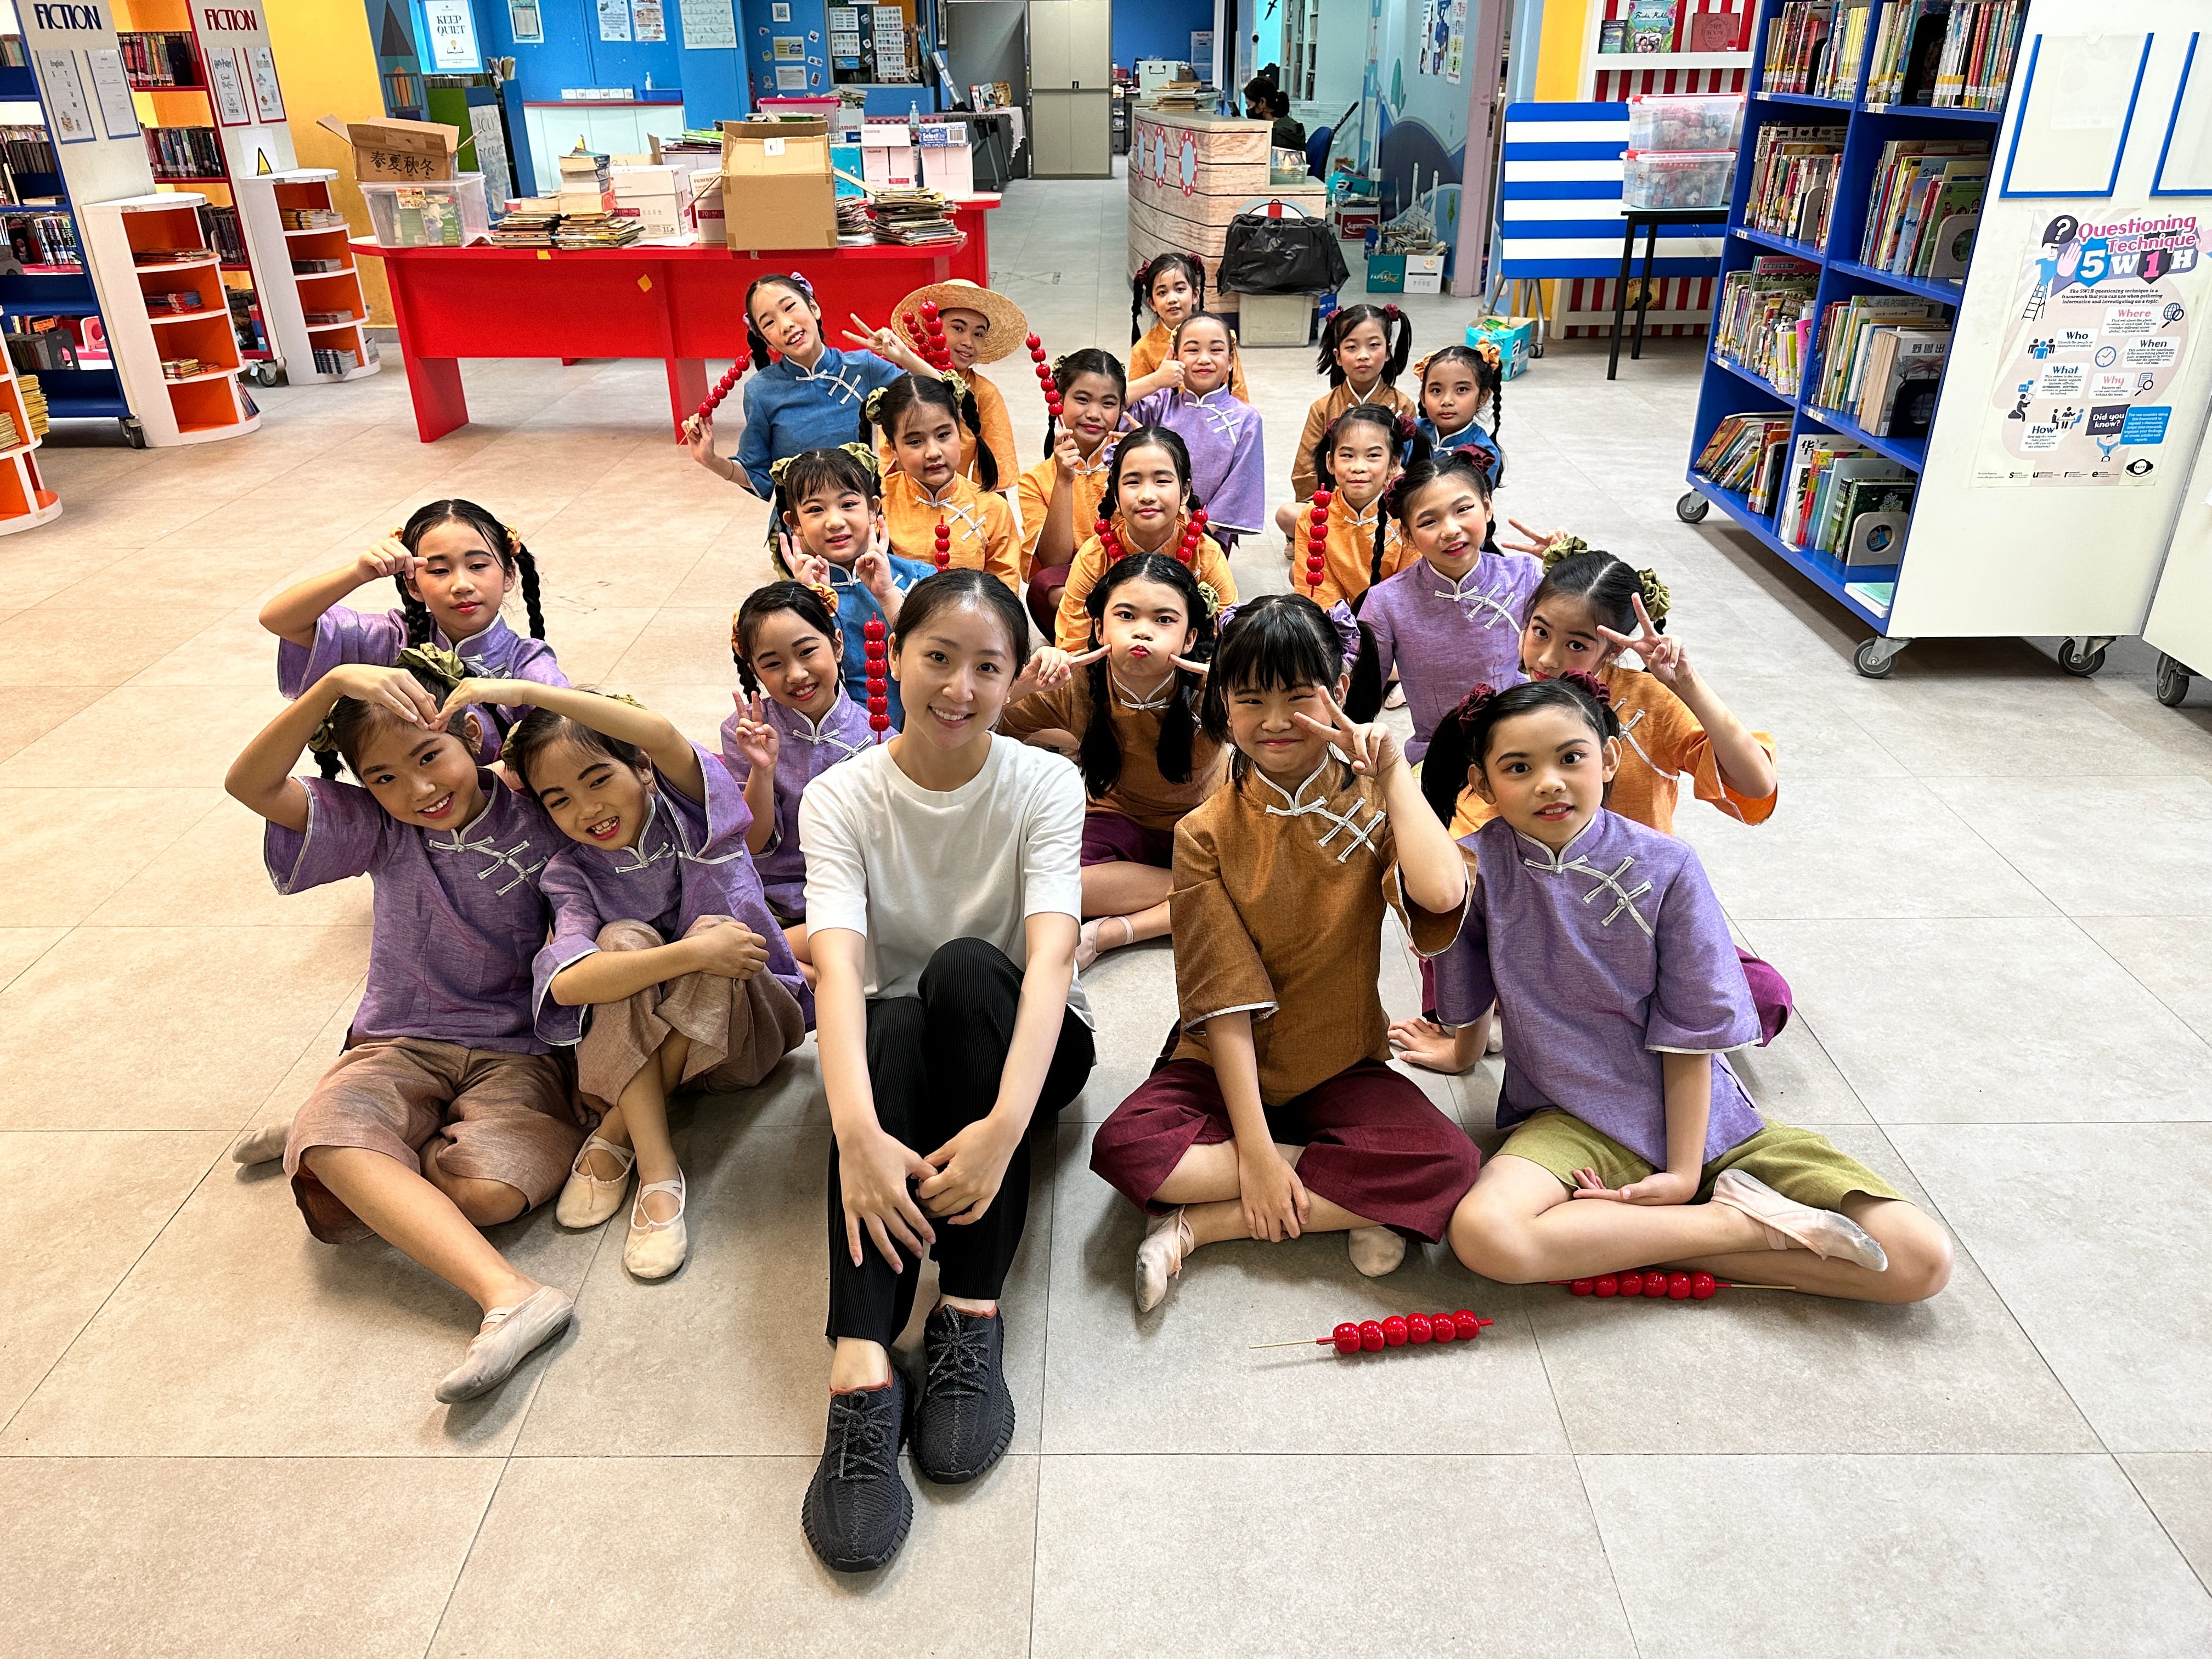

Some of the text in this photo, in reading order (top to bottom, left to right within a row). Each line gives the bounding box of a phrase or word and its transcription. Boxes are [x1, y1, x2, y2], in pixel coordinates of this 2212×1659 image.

[33, 3, 103, 30] FICTION
[204, 9, 258, 31] FICTION
[436, 15, 462, 25] KEEP
[437, 25, 465, 37] QUIET
[370, 151, 435, 176] 春夏秋冬
[2078, 214, 2196, 242] Questioning
[2108, 233, 2196, 252] Technique
[2118, 309, 2151, 317] Where
[2067, 331, 2089, 340] Who
[2140, 339, 2167, 348] When
[2053, 366, 2079, 374] What
[2103, 375, 2124, 386] Why
[2092, 412, 2125, 422] Did you
[2094, 420, 2121, 428] know?
[2032, 425, 2055, 434] How
